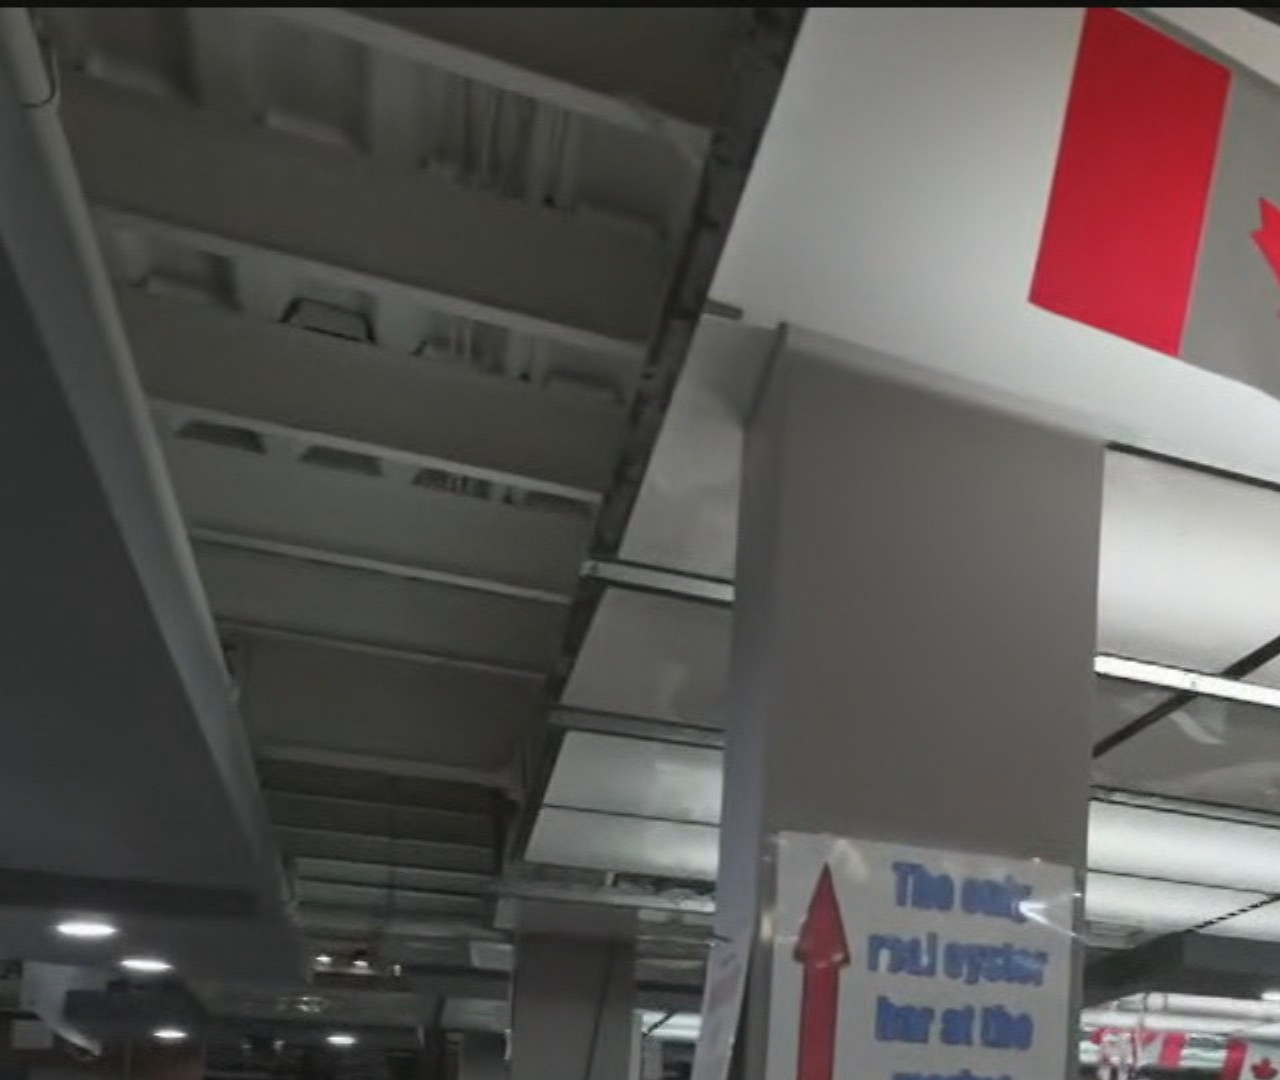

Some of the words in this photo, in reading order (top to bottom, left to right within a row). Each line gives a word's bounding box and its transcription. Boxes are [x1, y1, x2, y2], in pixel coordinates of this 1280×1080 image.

[892, 861, 954, 912] The
[867, 932, 937, 977] real
[943, 942, 1048, 985] oyster
[875, 996, 936, 1044] bar
[940, 1004, 976, 1047] at
[980, 1004, 1034, 1050] the
